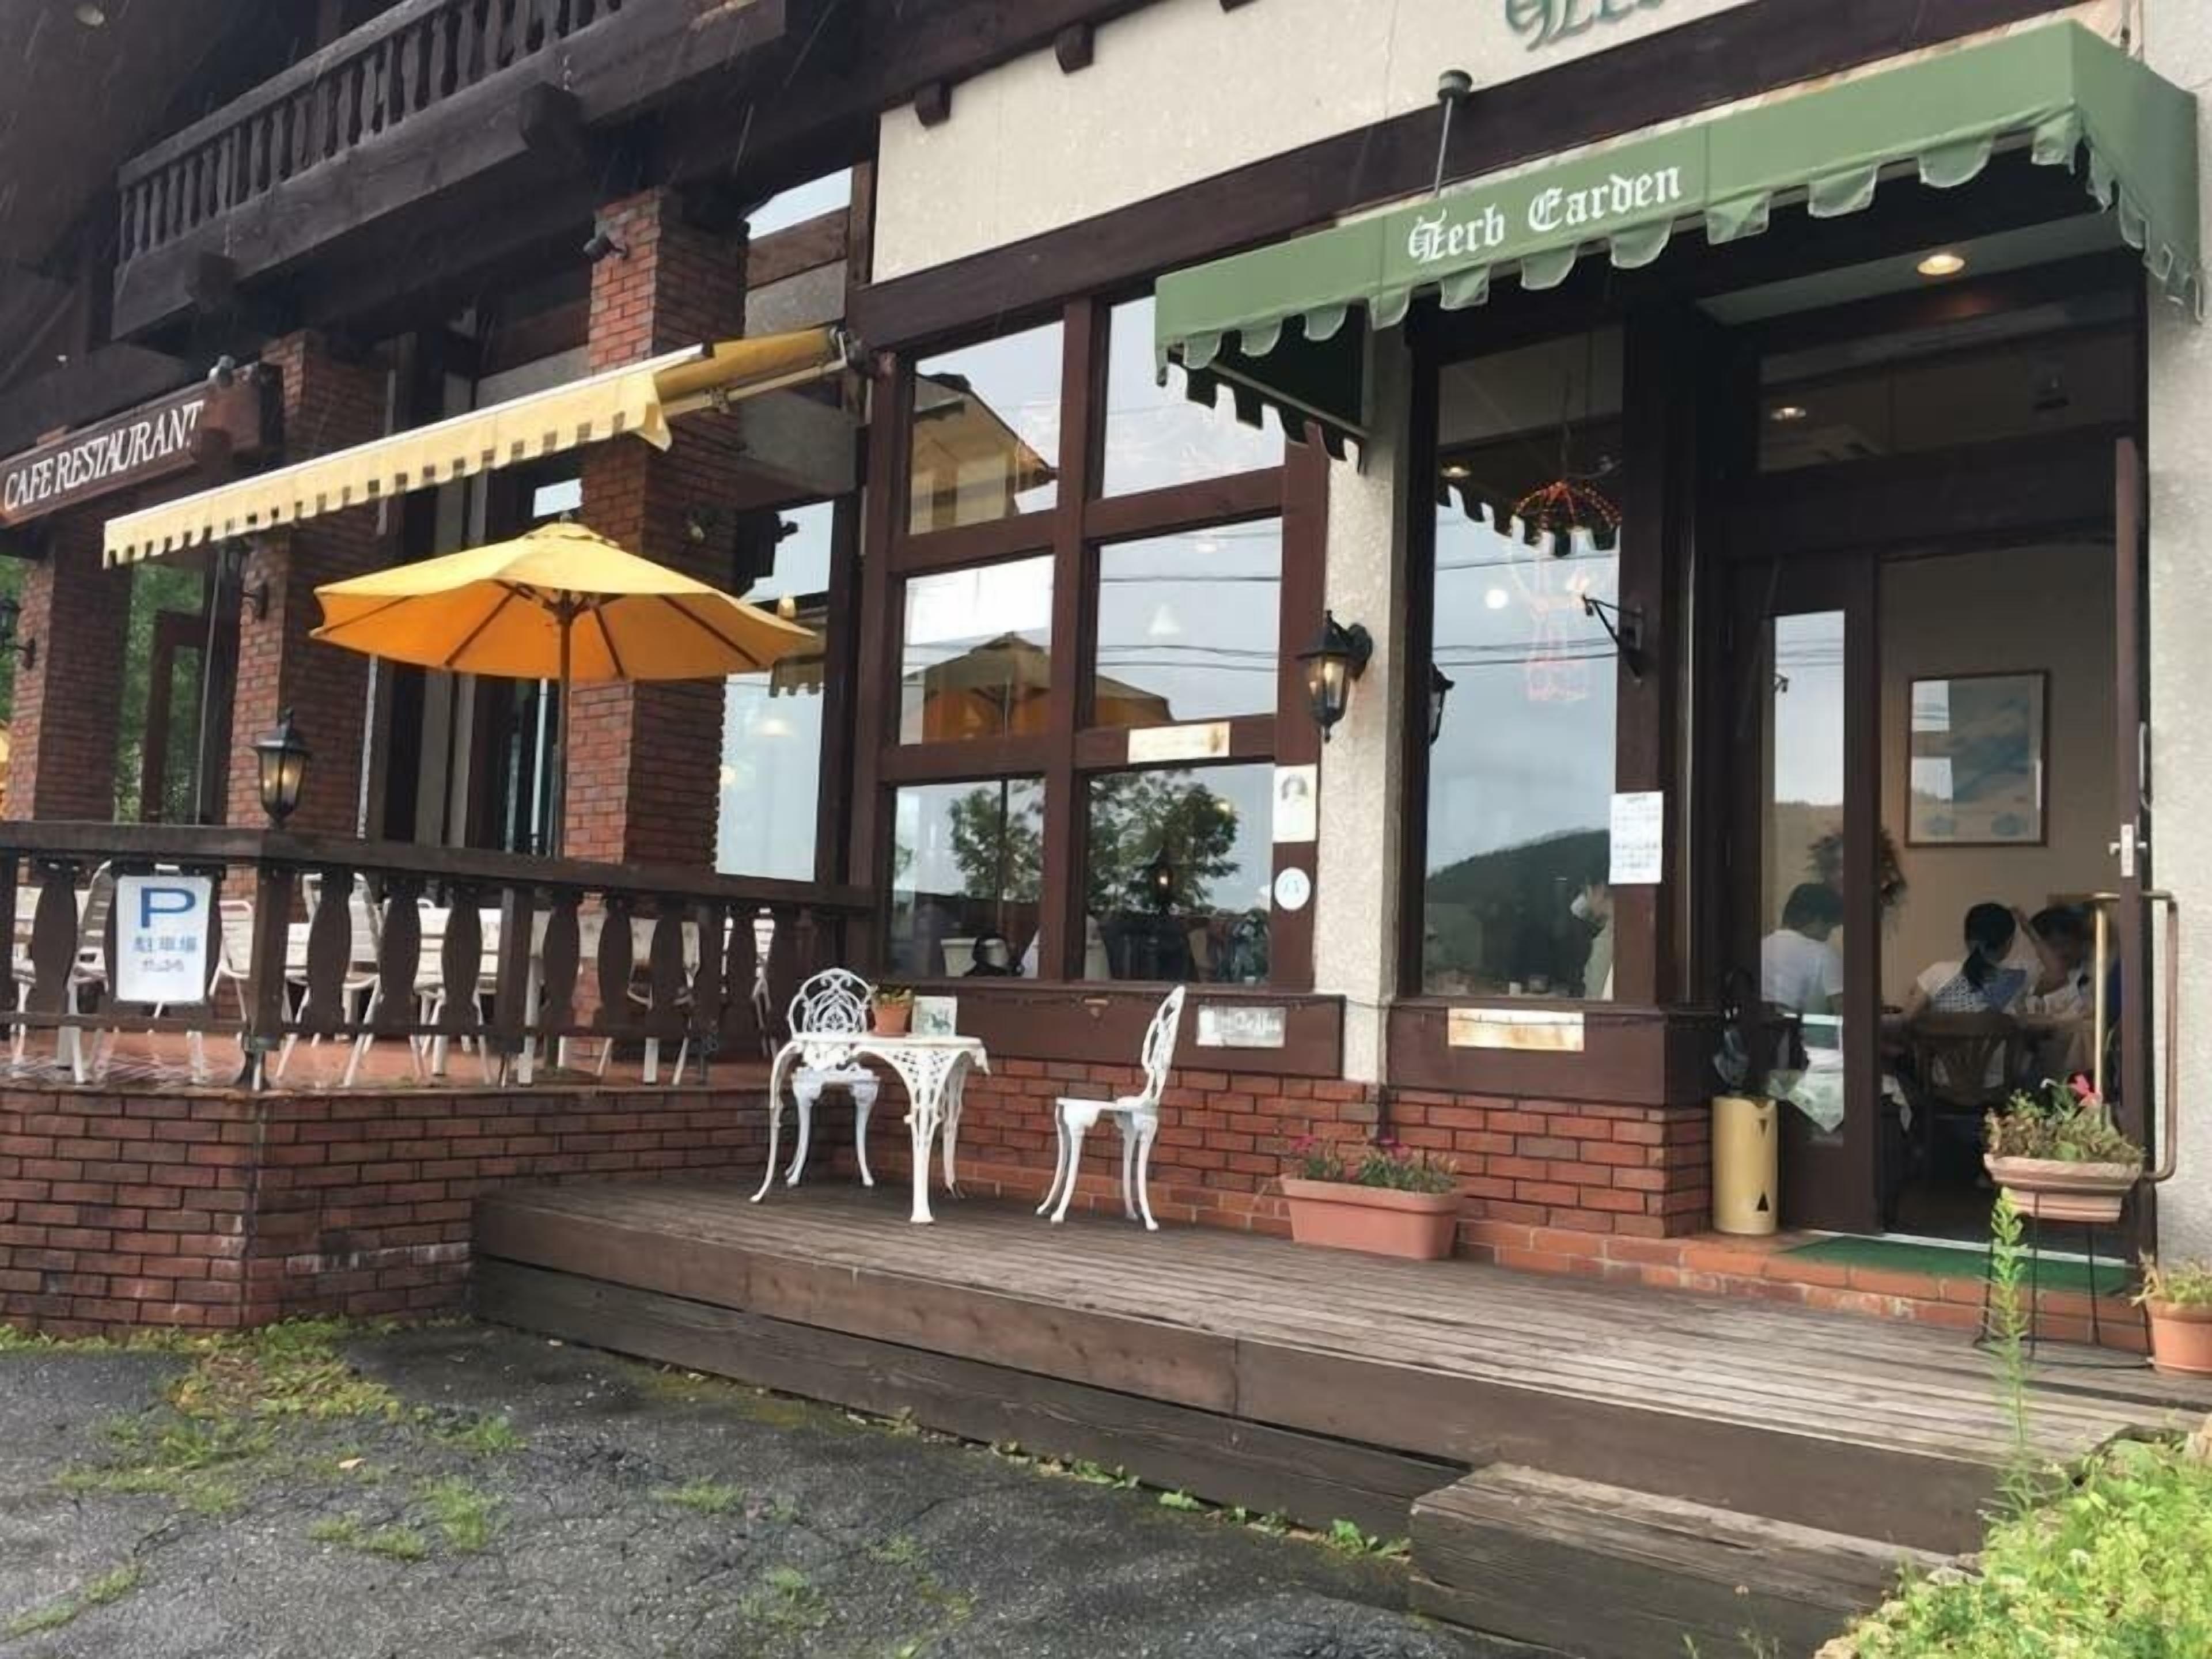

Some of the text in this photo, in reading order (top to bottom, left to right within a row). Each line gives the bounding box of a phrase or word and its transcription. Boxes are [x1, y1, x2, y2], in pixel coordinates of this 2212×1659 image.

[4, 399, 204, 512] CAFE RESTAURANT
[141, 885, 196, 929] P
